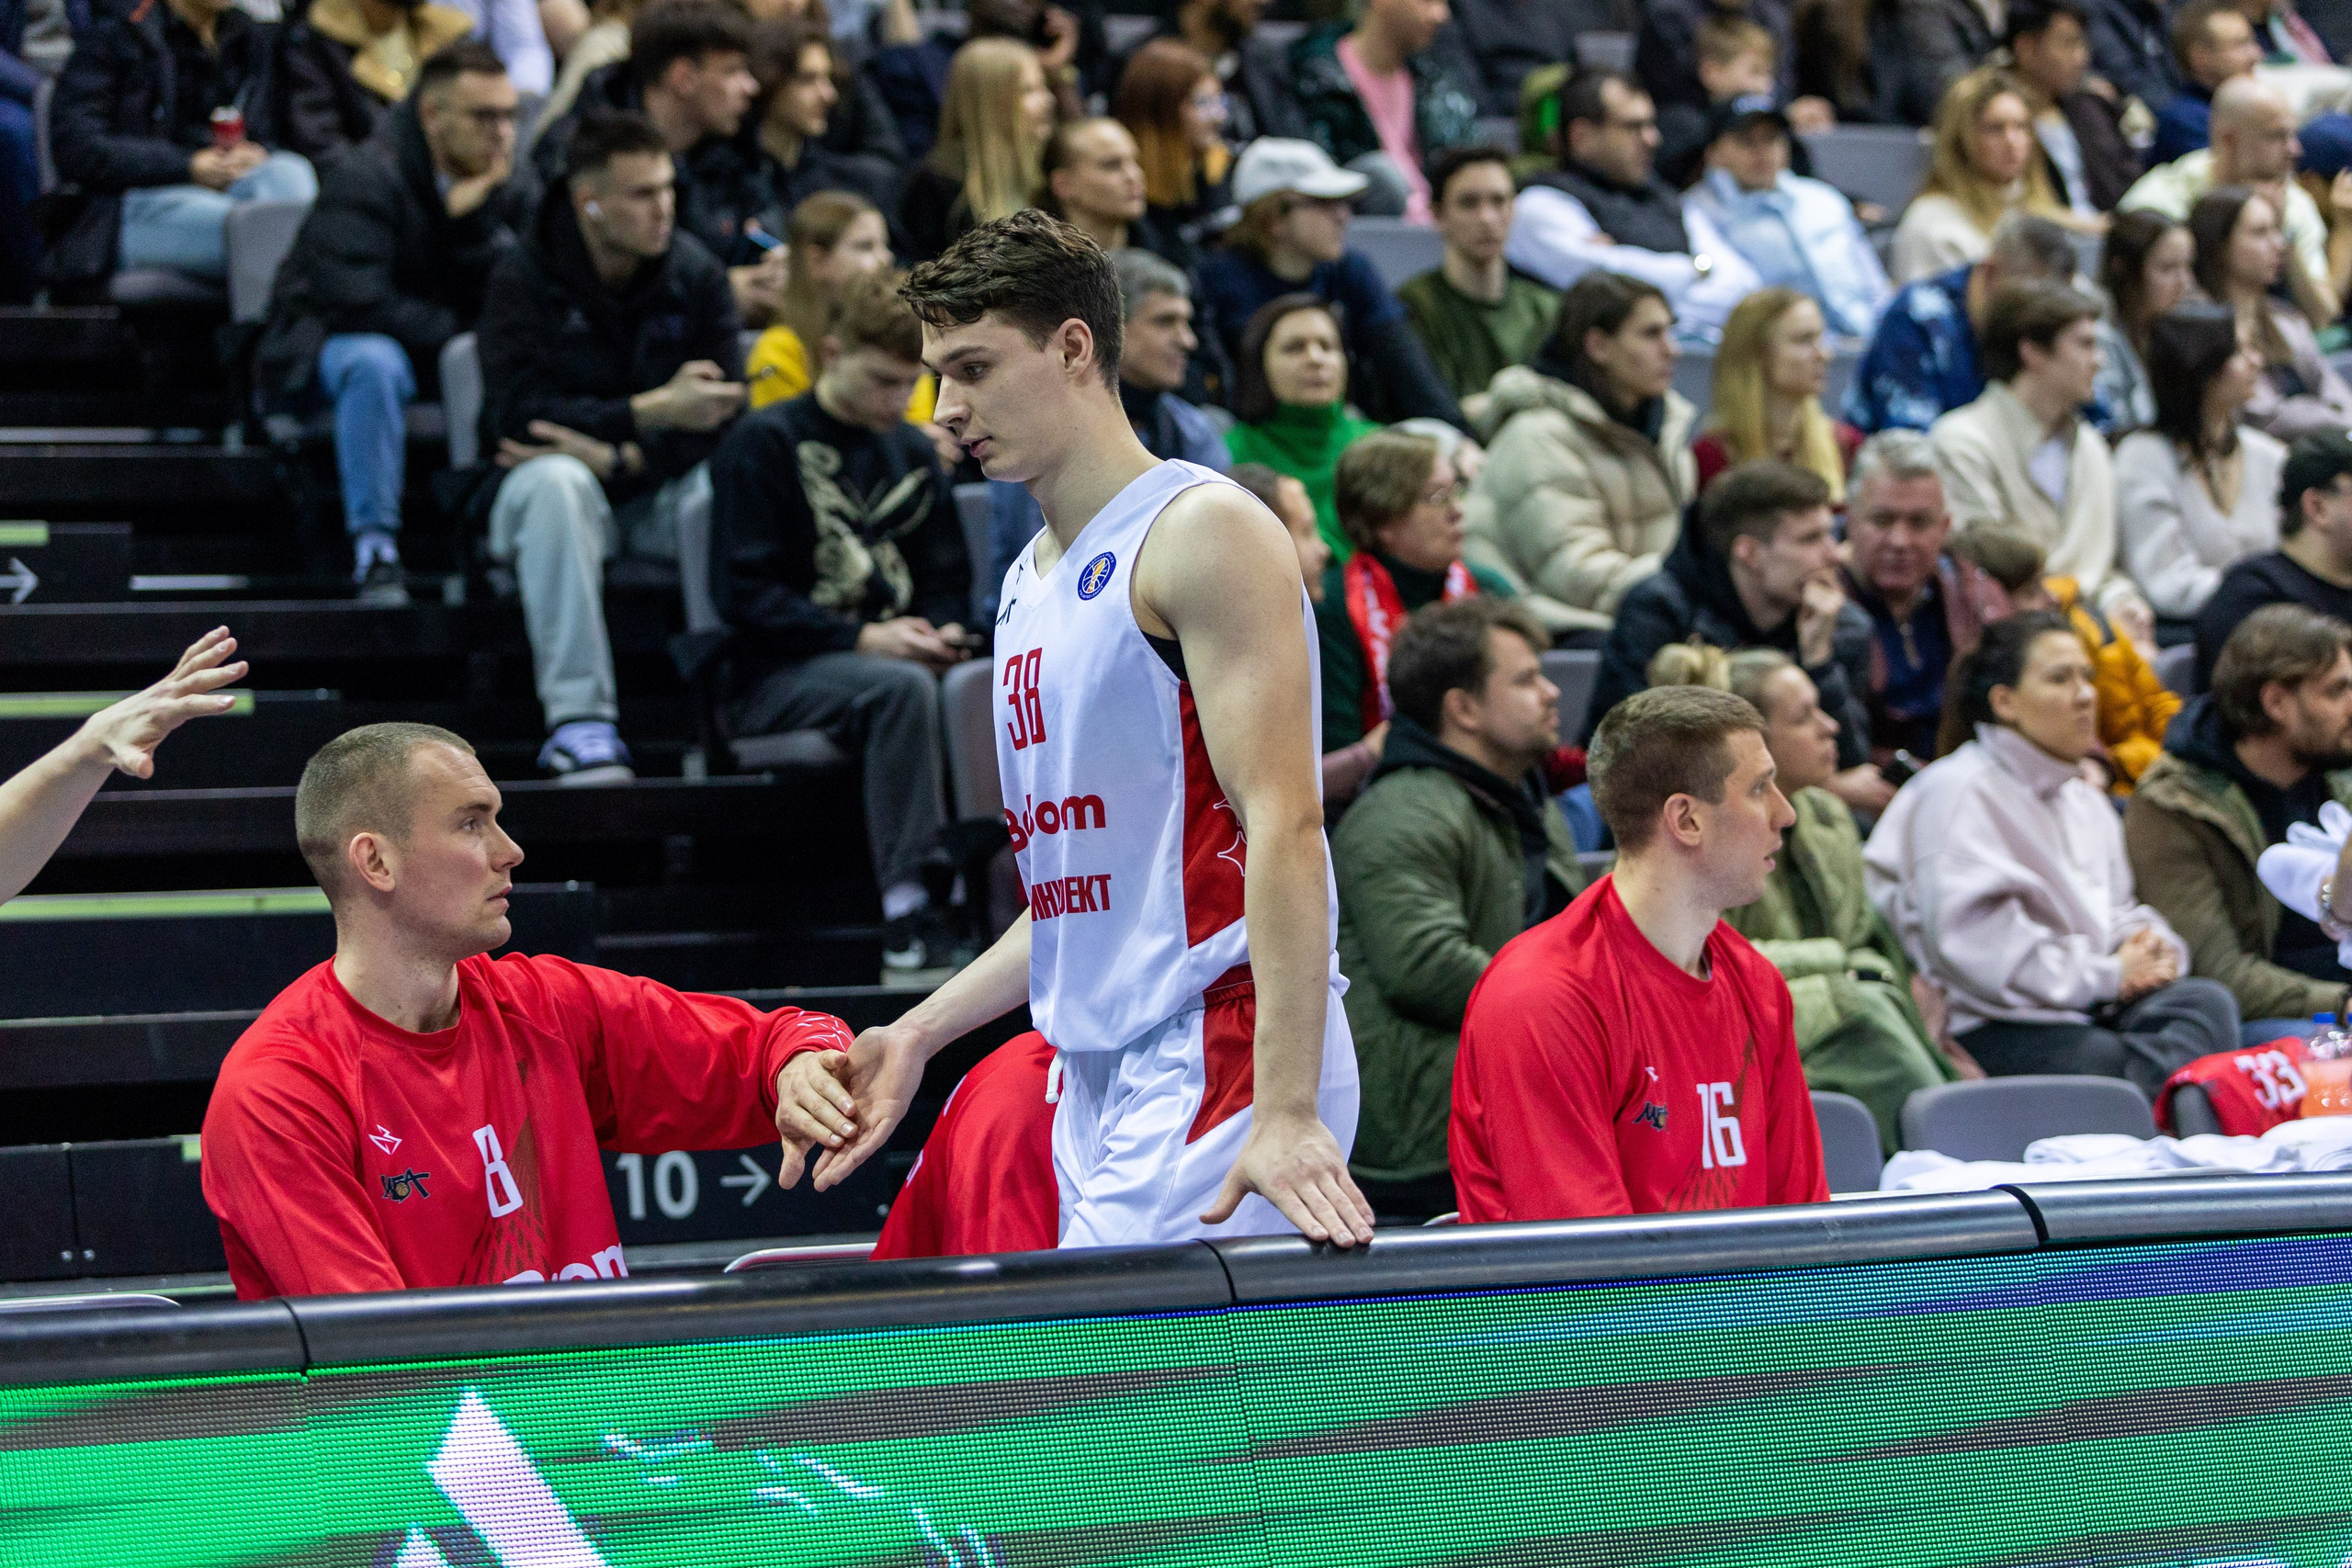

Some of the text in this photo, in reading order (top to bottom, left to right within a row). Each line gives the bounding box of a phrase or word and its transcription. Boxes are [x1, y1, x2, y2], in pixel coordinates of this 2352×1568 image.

[1003, 648, 1046, 751] 38
[2233, 1050, 2308, 1110] 33
[1696, 1081, 1747, 1169] 16
[472, 1123, 524, 1218] 8
[615, 1150, 698, 1221] 10
